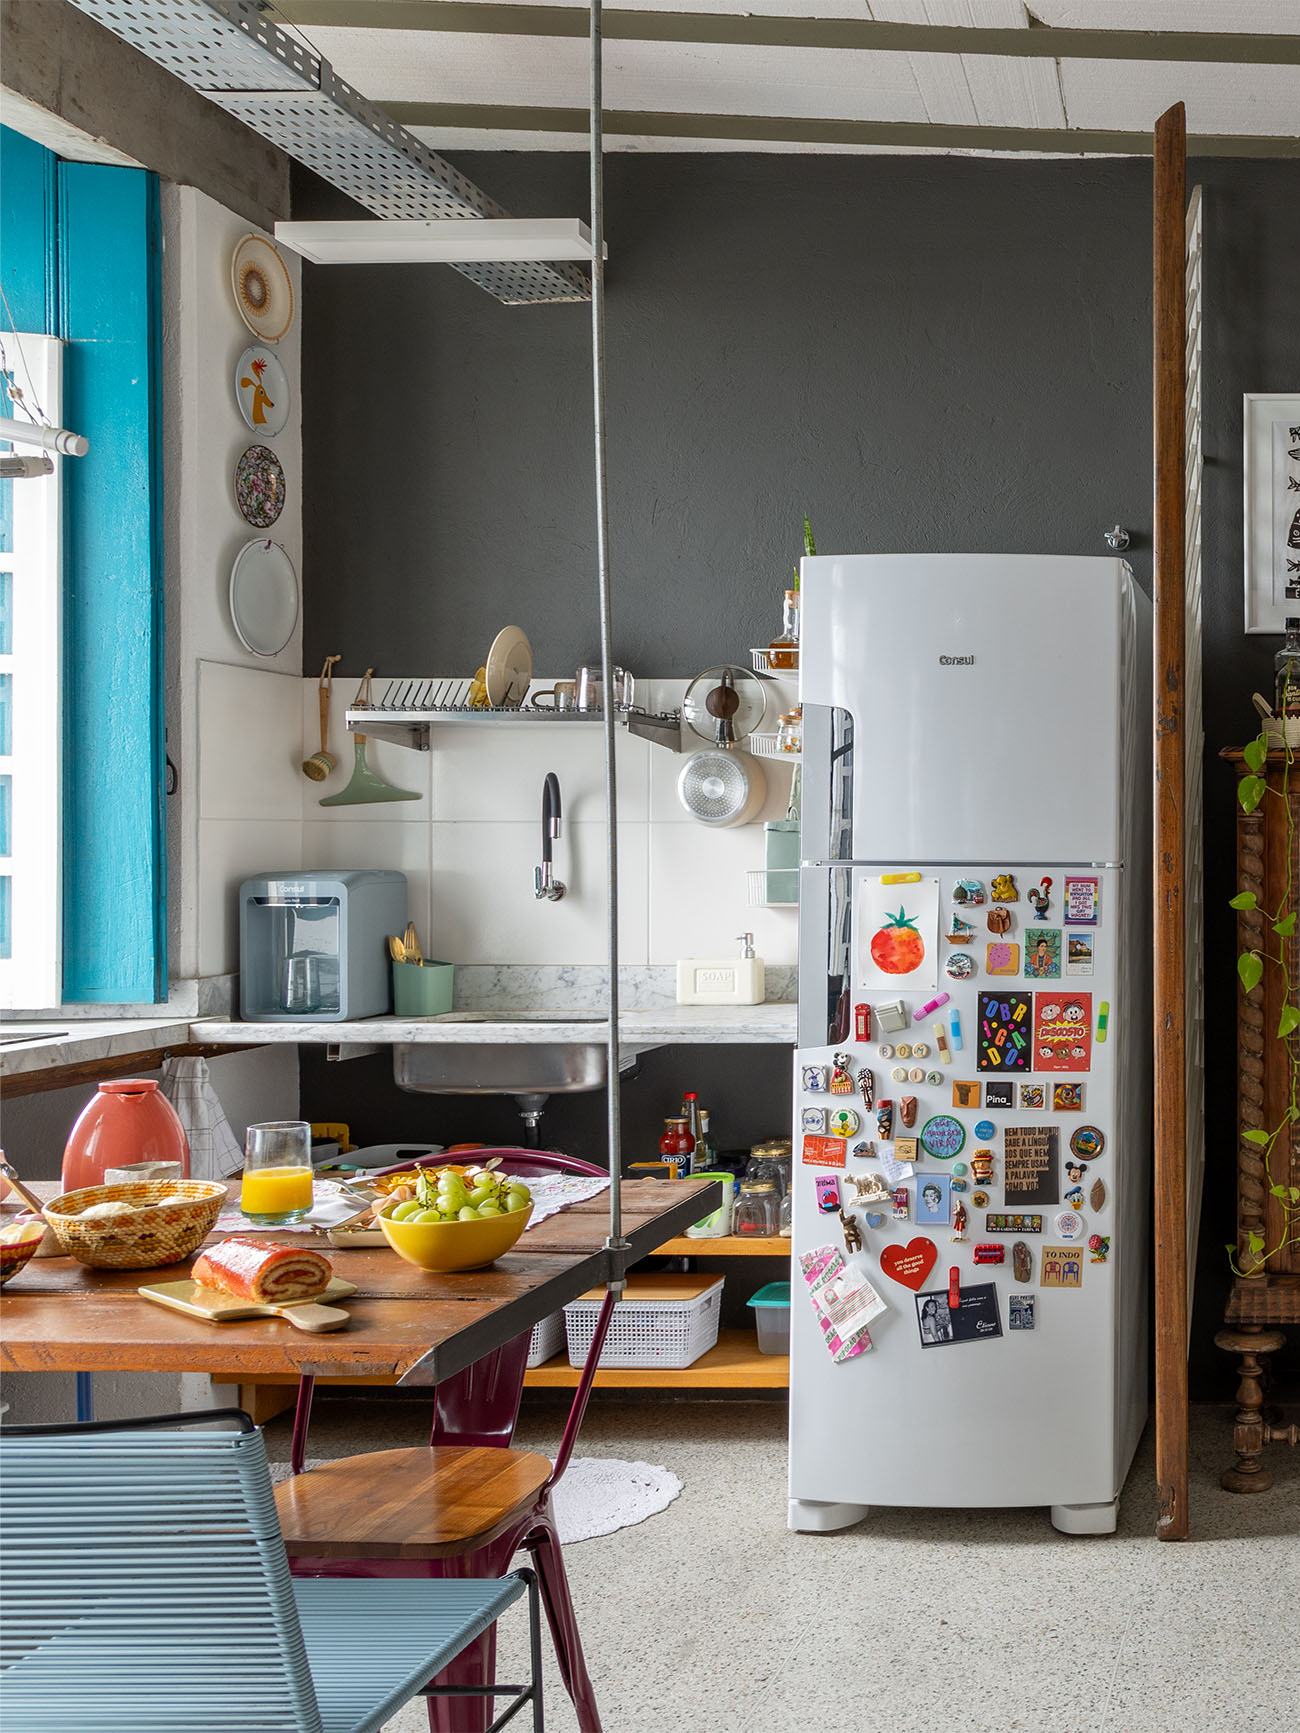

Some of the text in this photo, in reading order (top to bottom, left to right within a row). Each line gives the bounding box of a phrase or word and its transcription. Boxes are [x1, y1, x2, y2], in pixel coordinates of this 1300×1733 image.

[939, 654, 974, 666] Consul
[280, 885, 305, 893] Consul
[702, 971, 732, 982] SOAP
[1020, 1127, 1037, 1137] TODO
[1005, 1138, 1021, 1148] SABE
[1021, 1137, 1027, 1148] A
[1019, 1149, 1033, 1159] QUE
[1034, 1148, 1049, 1158] NEM
[1005, 1159, 1049, 1170] SEMPRE USAM
[1058, 1251, 1081, 1259] INDO
